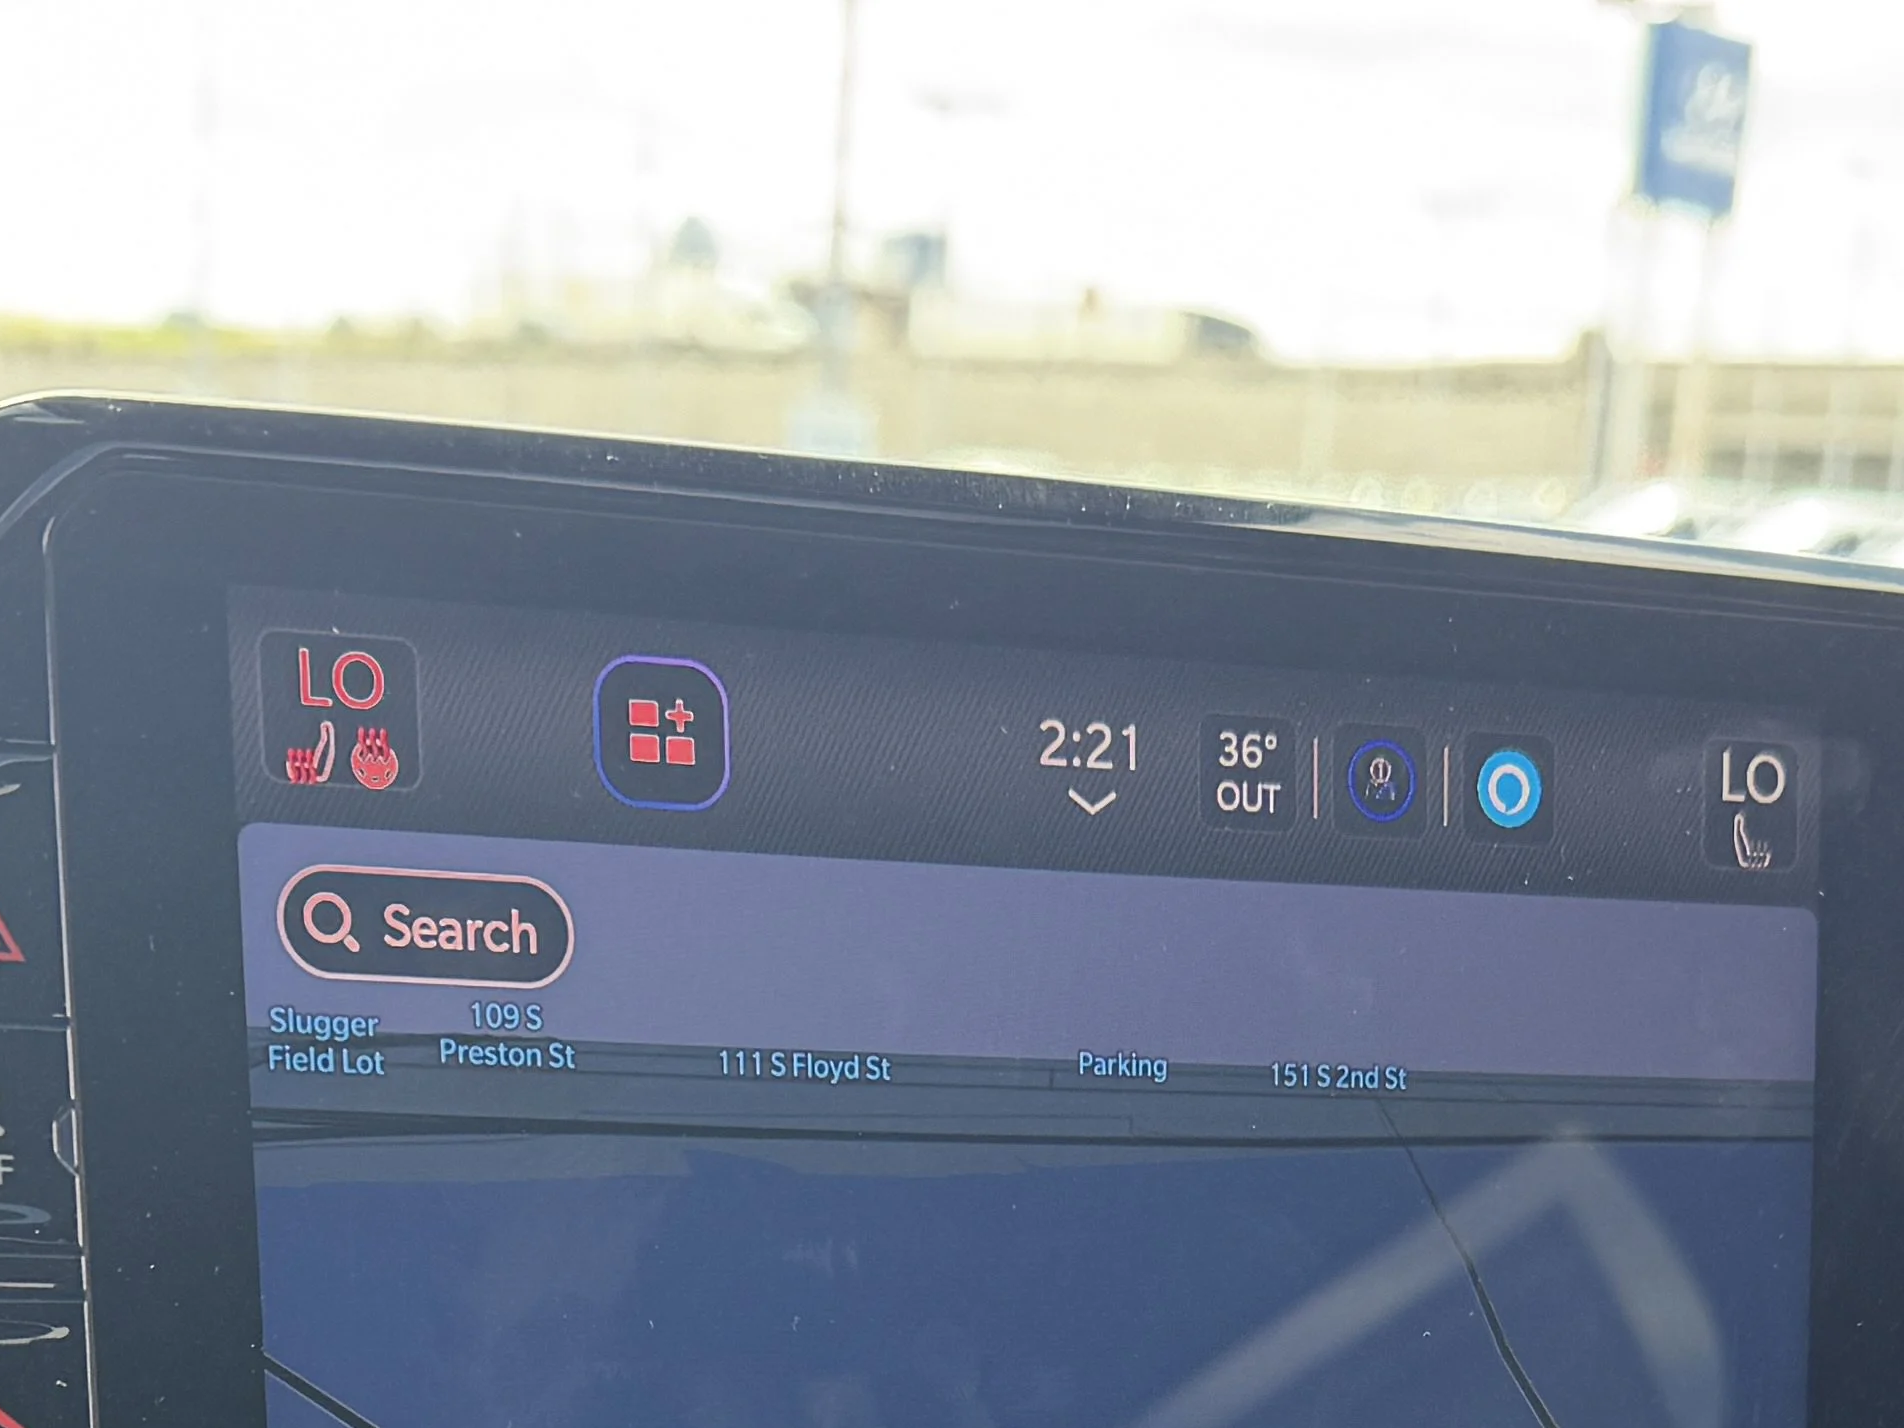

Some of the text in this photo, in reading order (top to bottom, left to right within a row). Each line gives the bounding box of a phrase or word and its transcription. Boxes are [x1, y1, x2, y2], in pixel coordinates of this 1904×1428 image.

[298, 646, 385, 709] LO
[1039, 719, 1138, 771] 2:21
[1218, 731, 1278, 768] 36°
[1722, 745, 1786, 805] LO
[1216, 781, 1281, 815] OUT
[383, 902, 538, 956] Search
[269, 1006, 379, 1042] Slugger
[470, 1002, 543, 1032] 109 S
[268, 1044, 385, 1077] Field Lot
[439, 1039, 576, 1070] Preston St
[718, 1050, 892, 1083] 111 S Floyd St
[1078, 1051, 1168, 1083] Parking
[1271, 1060, 1407, 1091] 151 S 2nd St
